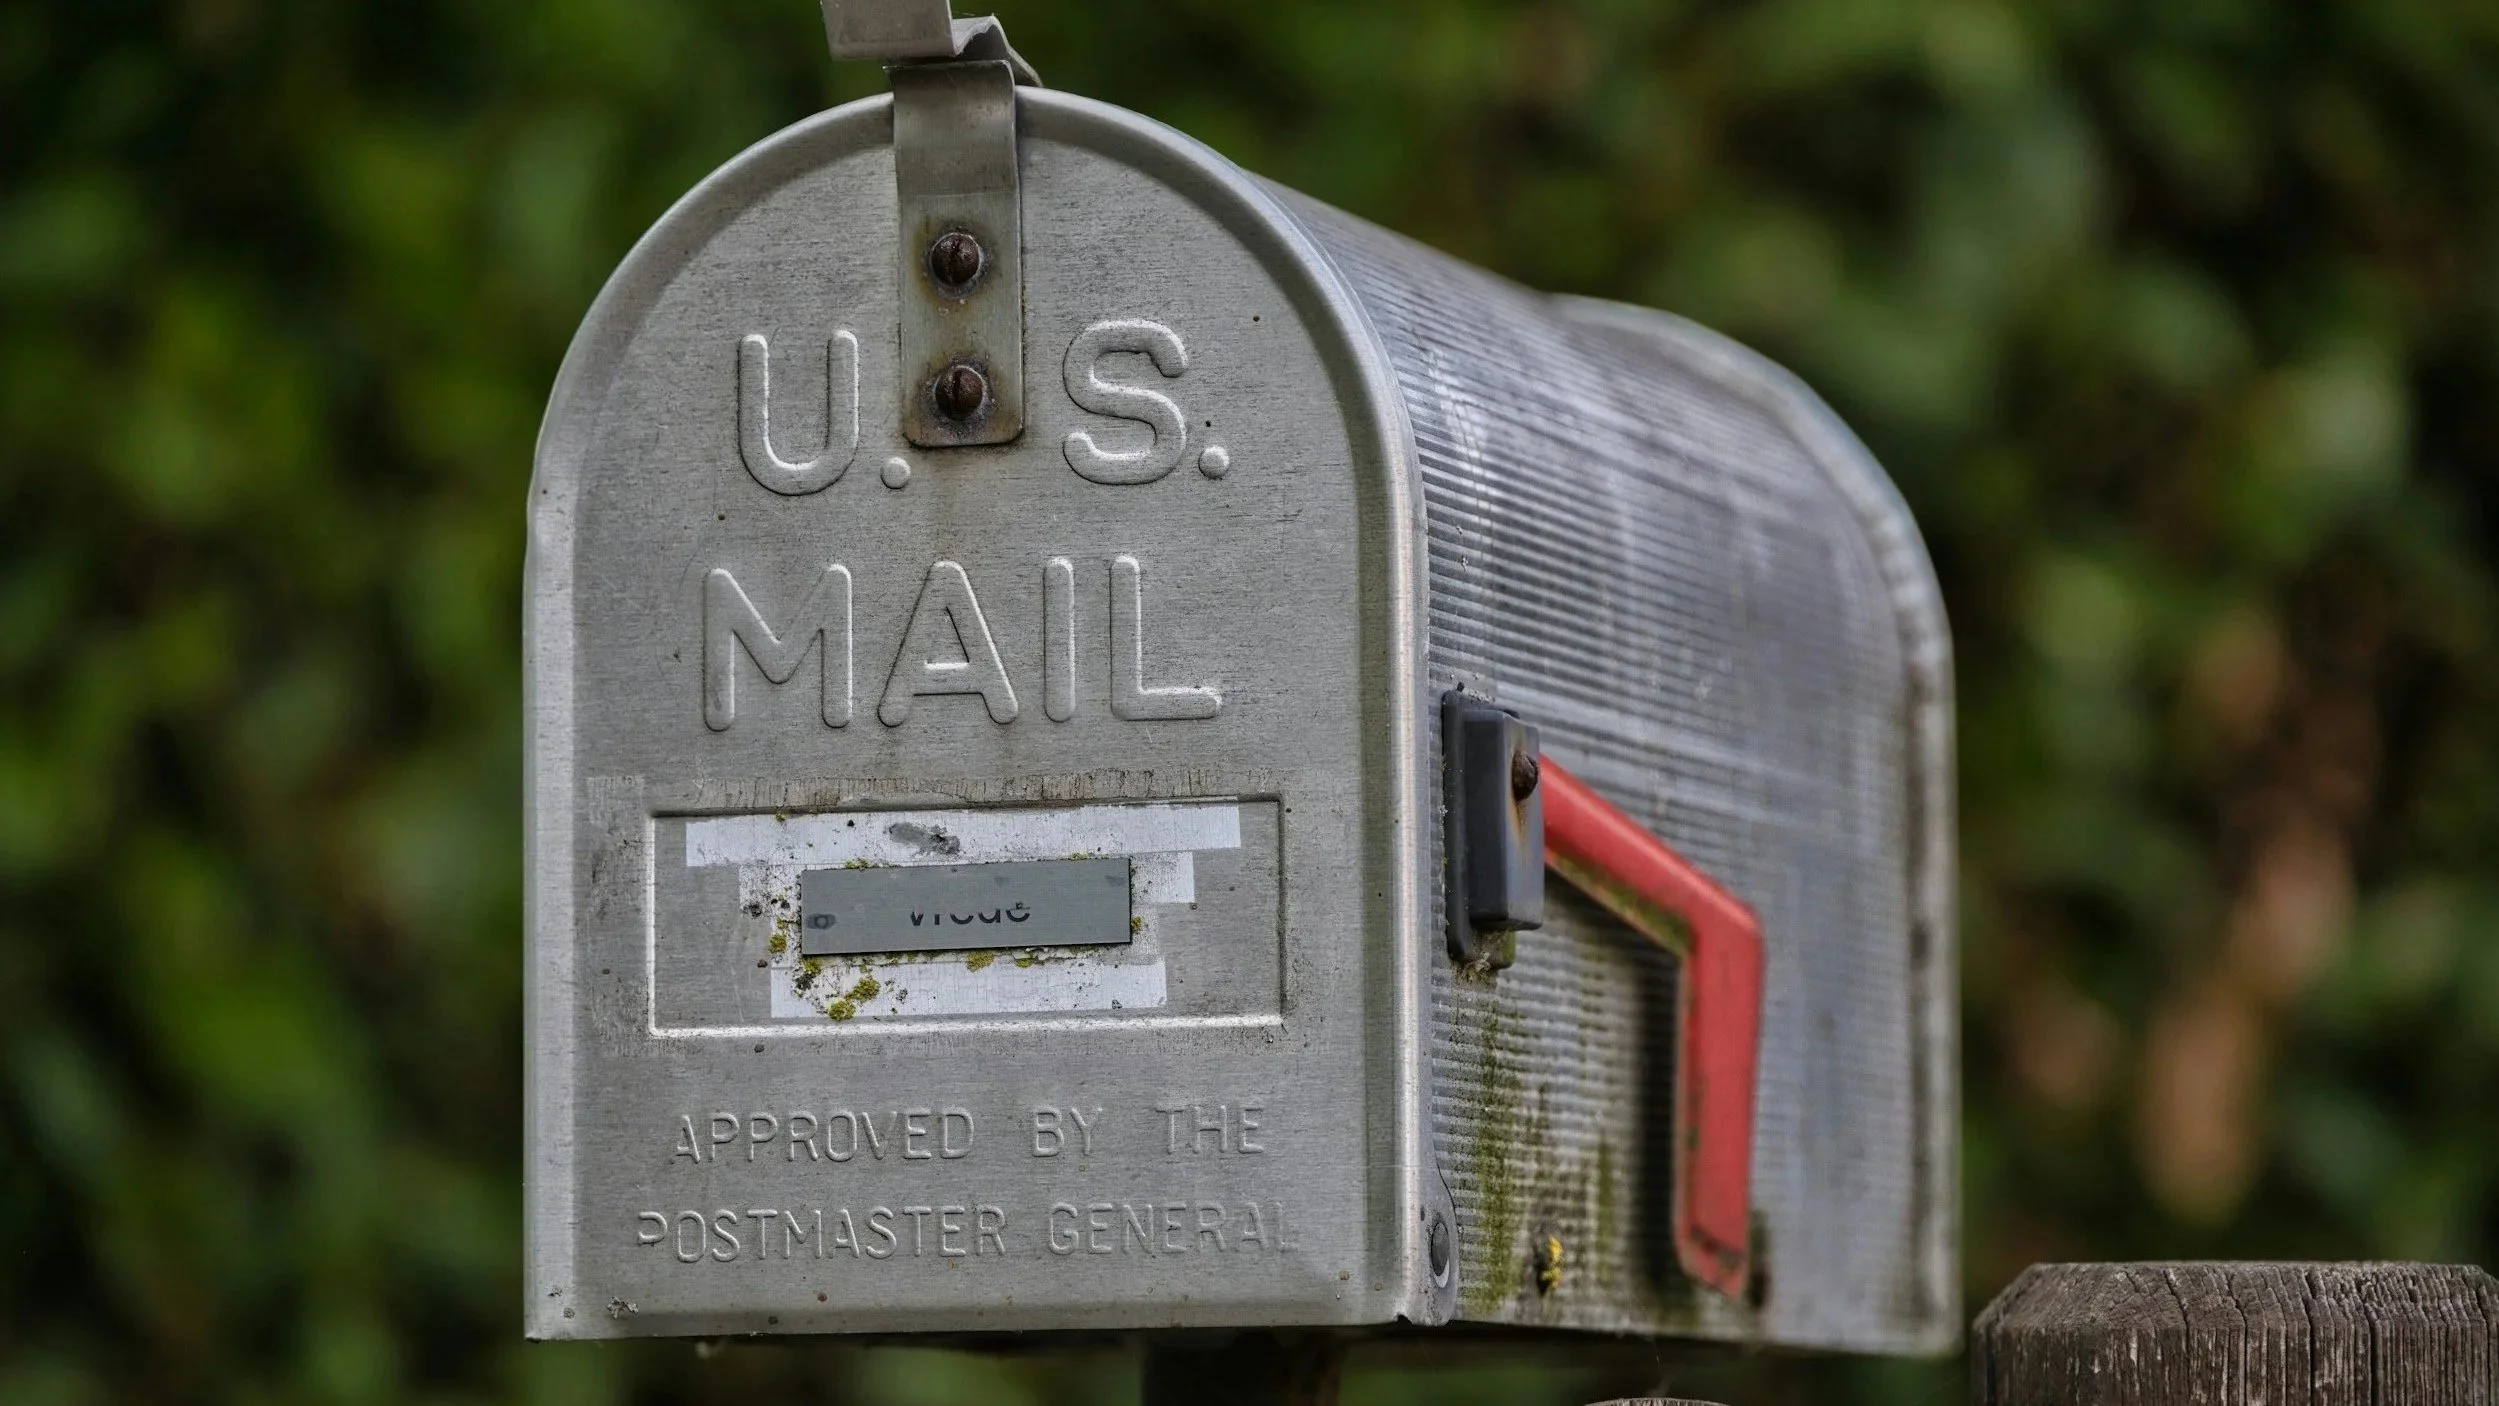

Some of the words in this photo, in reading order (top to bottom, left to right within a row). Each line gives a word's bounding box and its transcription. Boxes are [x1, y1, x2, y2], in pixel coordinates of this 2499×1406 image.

[738, 329, 911, 495] U.
[1063, 319, 1230, 485] S.
[704, 555, 1222, 731] MAIL
[670, 1107, 975, 1164] APPROVED
[1033, 1106, 1103, 1157] BY
[1155, 1105, 1264, 1155] THE
[637, 1204, 1006, 1263] POSTMASTER
[1049, 1201, 1299, 1256] GENERAL
